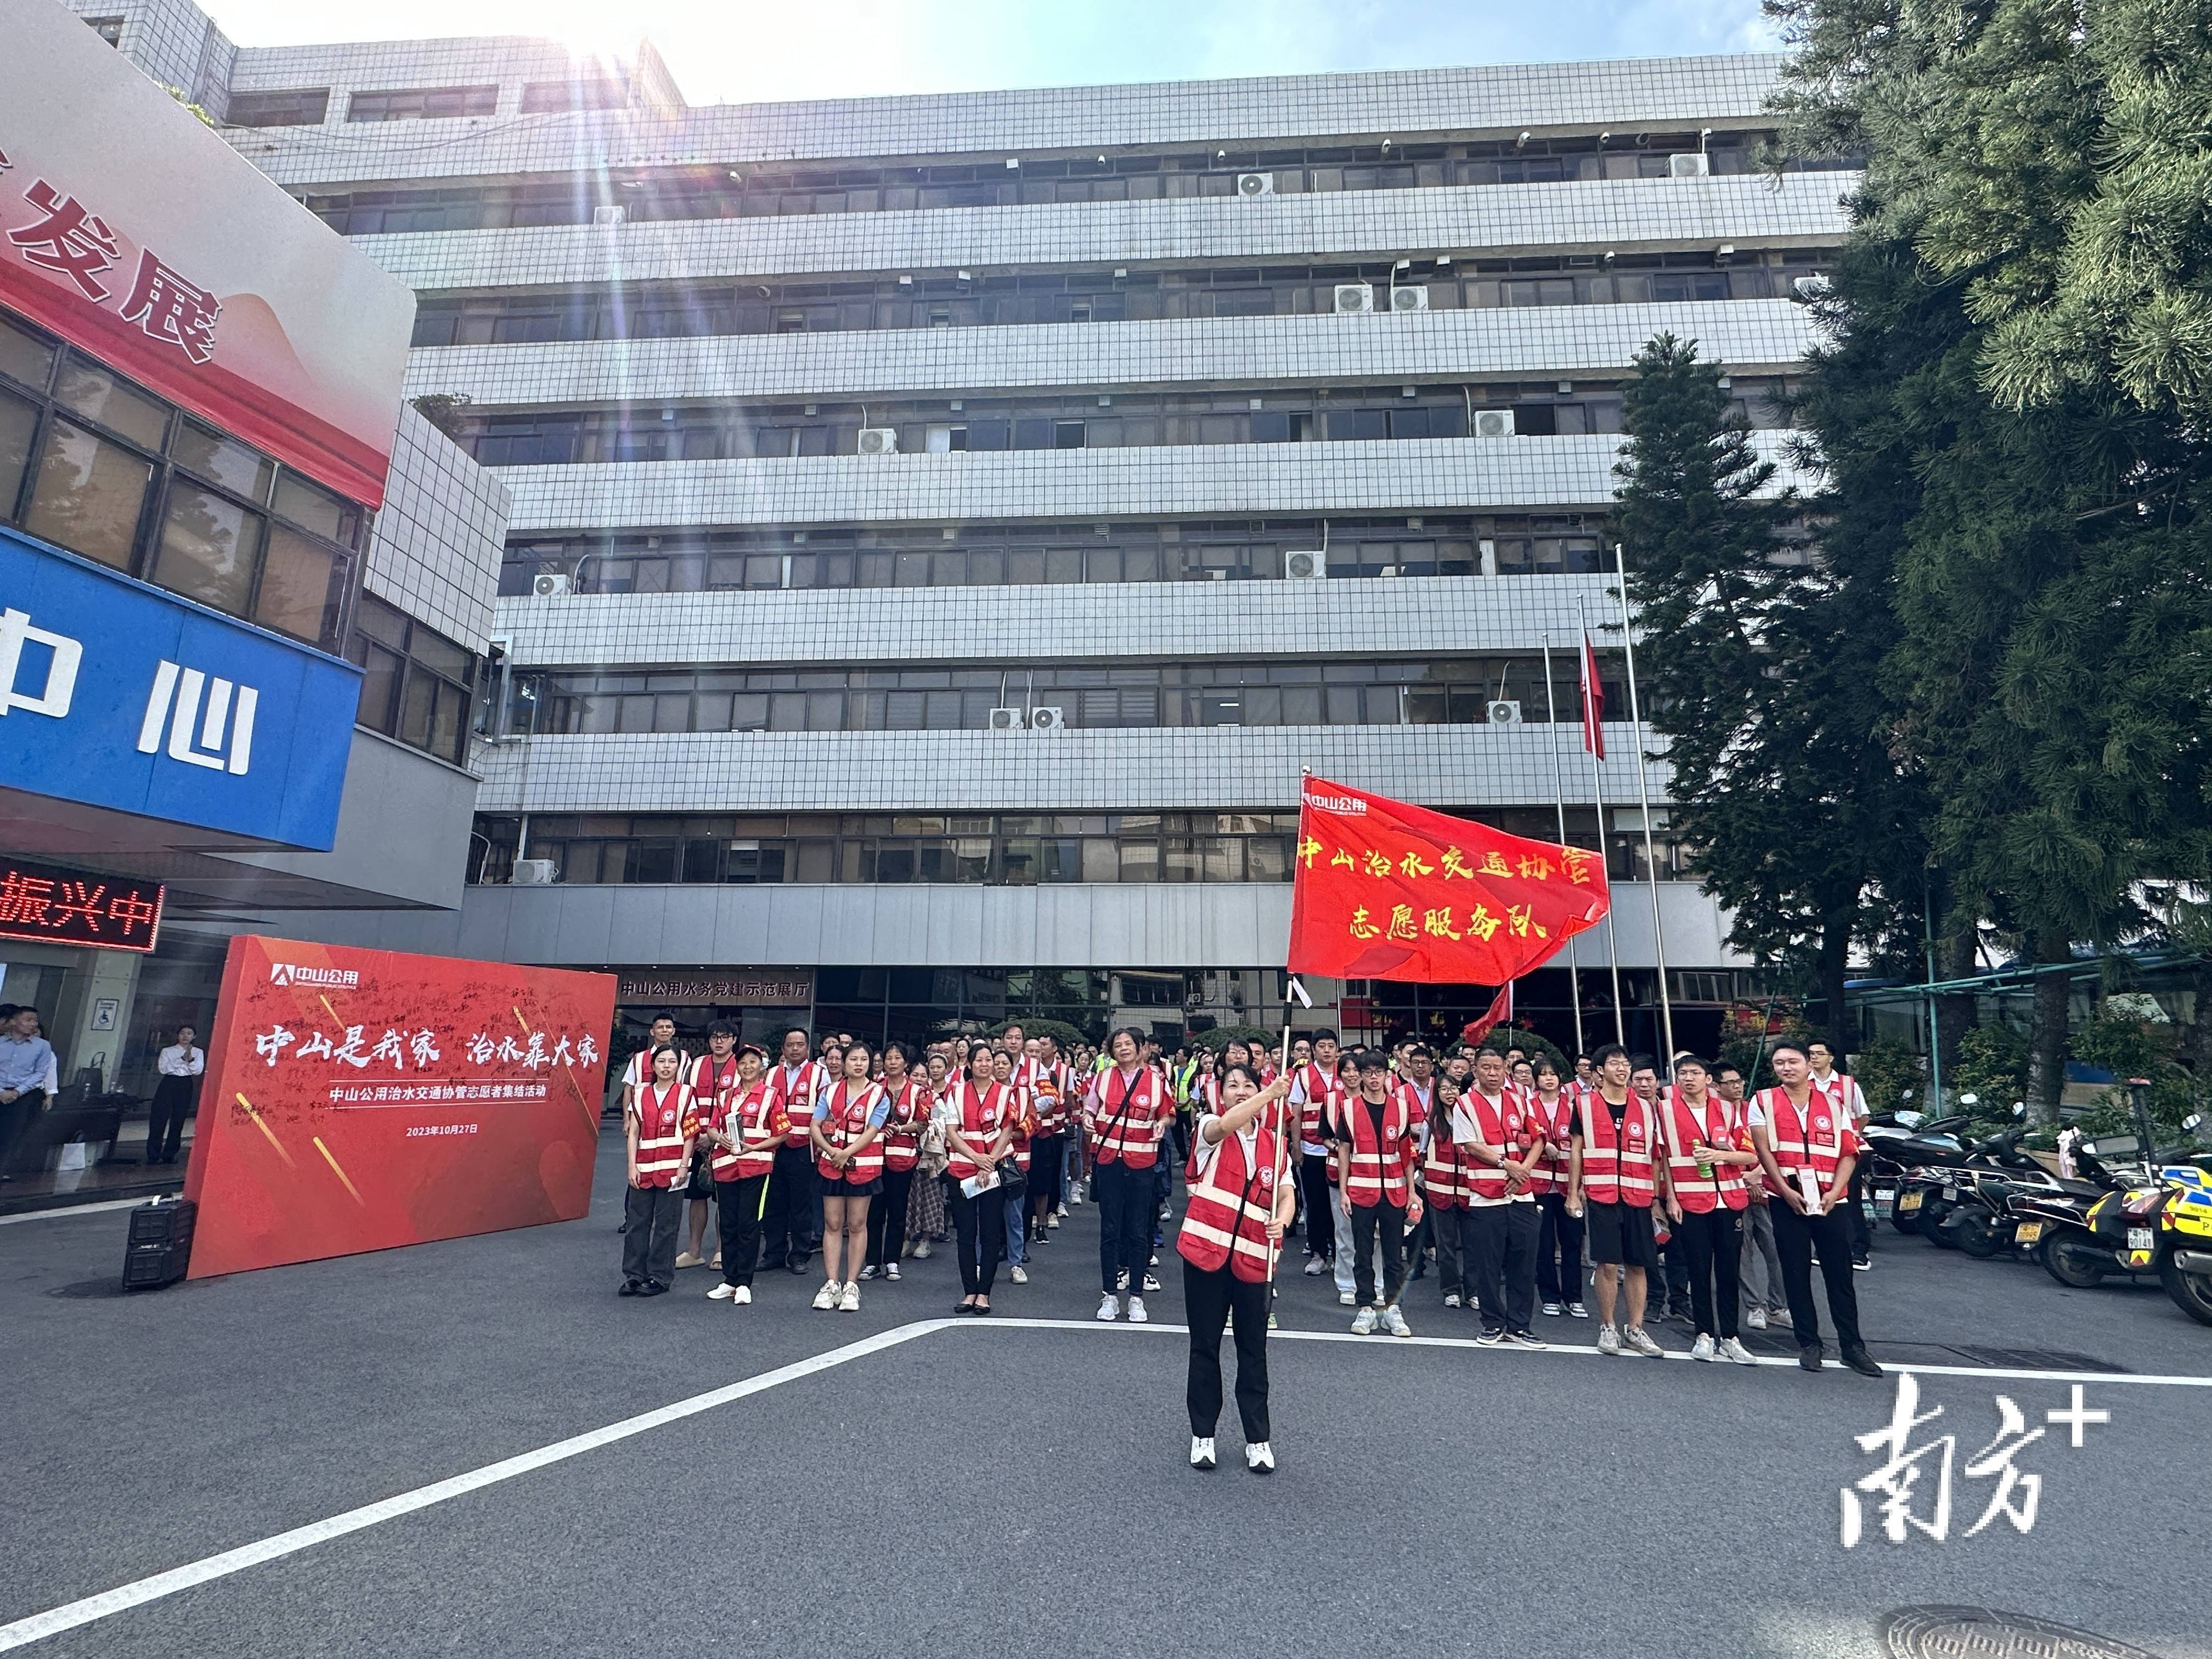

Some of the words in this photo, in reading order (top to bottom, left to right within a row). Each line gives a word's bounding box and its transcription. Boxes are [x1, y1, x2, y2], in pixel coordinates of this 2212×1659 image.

[0, 146, 223, 365] 发展
[0, 607, 258, 776] 中心
[1312, 795, 1367, 812] 中山公用
[1297, 836, 1594, 885] 中山治水交通协管
[1348, 902, 1548, 943] 志愿服务队
[296, 967, 359, 984] 中山公用
[621, 981, 810, 997] 中山公用水务党建示范展厅
[256, 1025, 439, 1069] 中山是我家
[465, 1030, 599, 1070] 治水靠大家
[329, 1084, 546, 1102] 中山公用治水交通协管志愿者集结活动
[405, 1124, 478, 1137] 2023年10月27日
[2203, 1222, 2212, 1231] P
